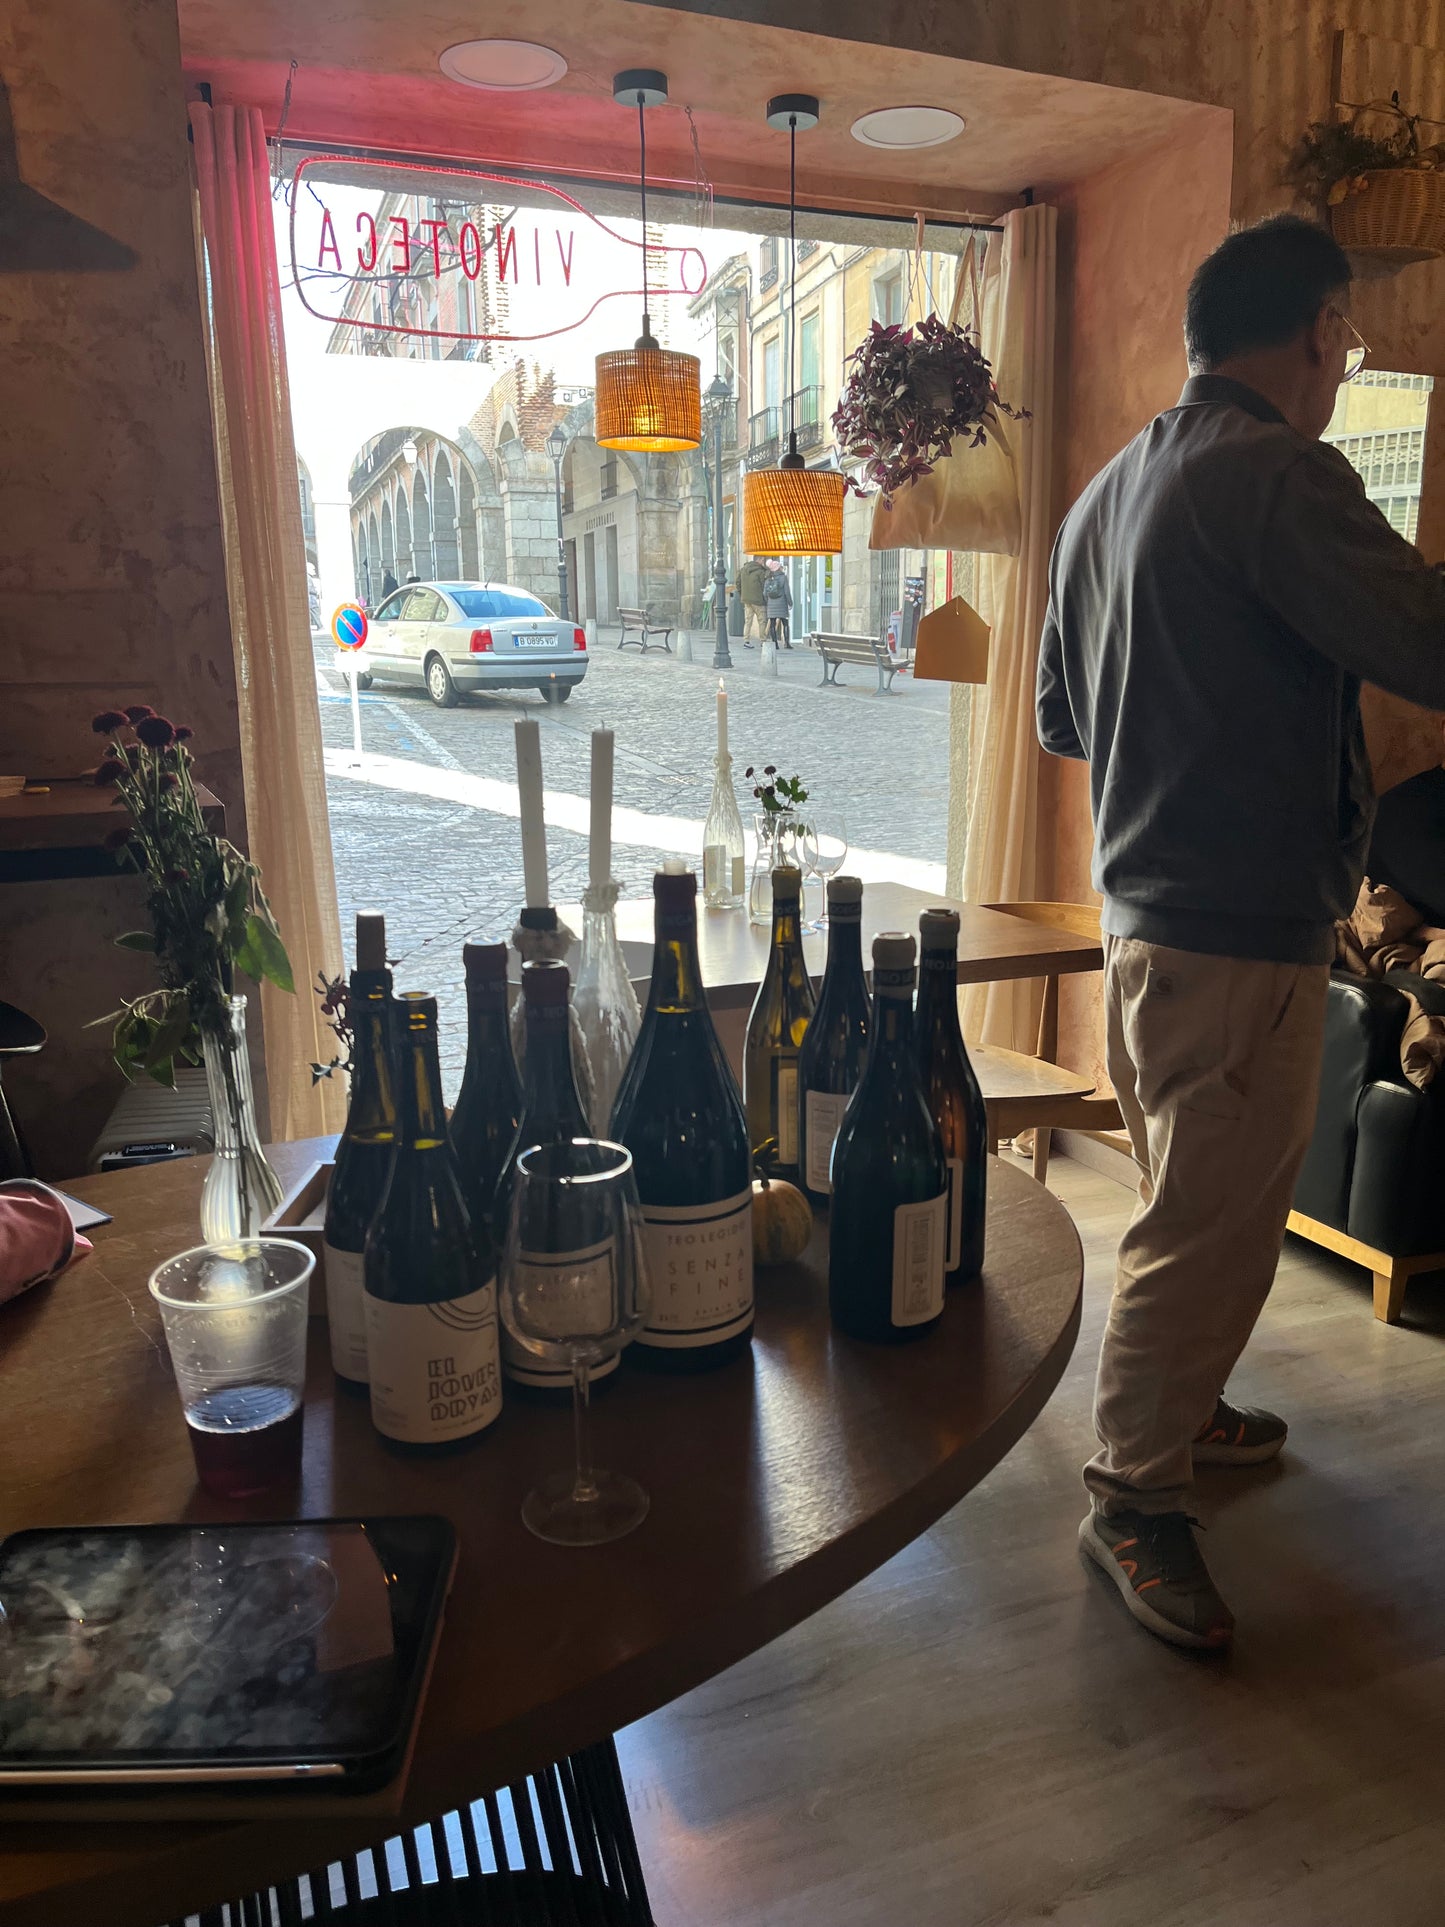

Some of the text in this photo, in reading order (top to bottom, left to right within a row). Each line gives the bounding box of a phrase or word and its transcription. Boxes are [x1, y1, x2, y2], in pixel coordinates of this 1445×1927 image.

[667, 1247, 746, 1275] SENZA
[669, 1267, 745, 1296] FINE
[427, 1356, 456, 1378] EL
